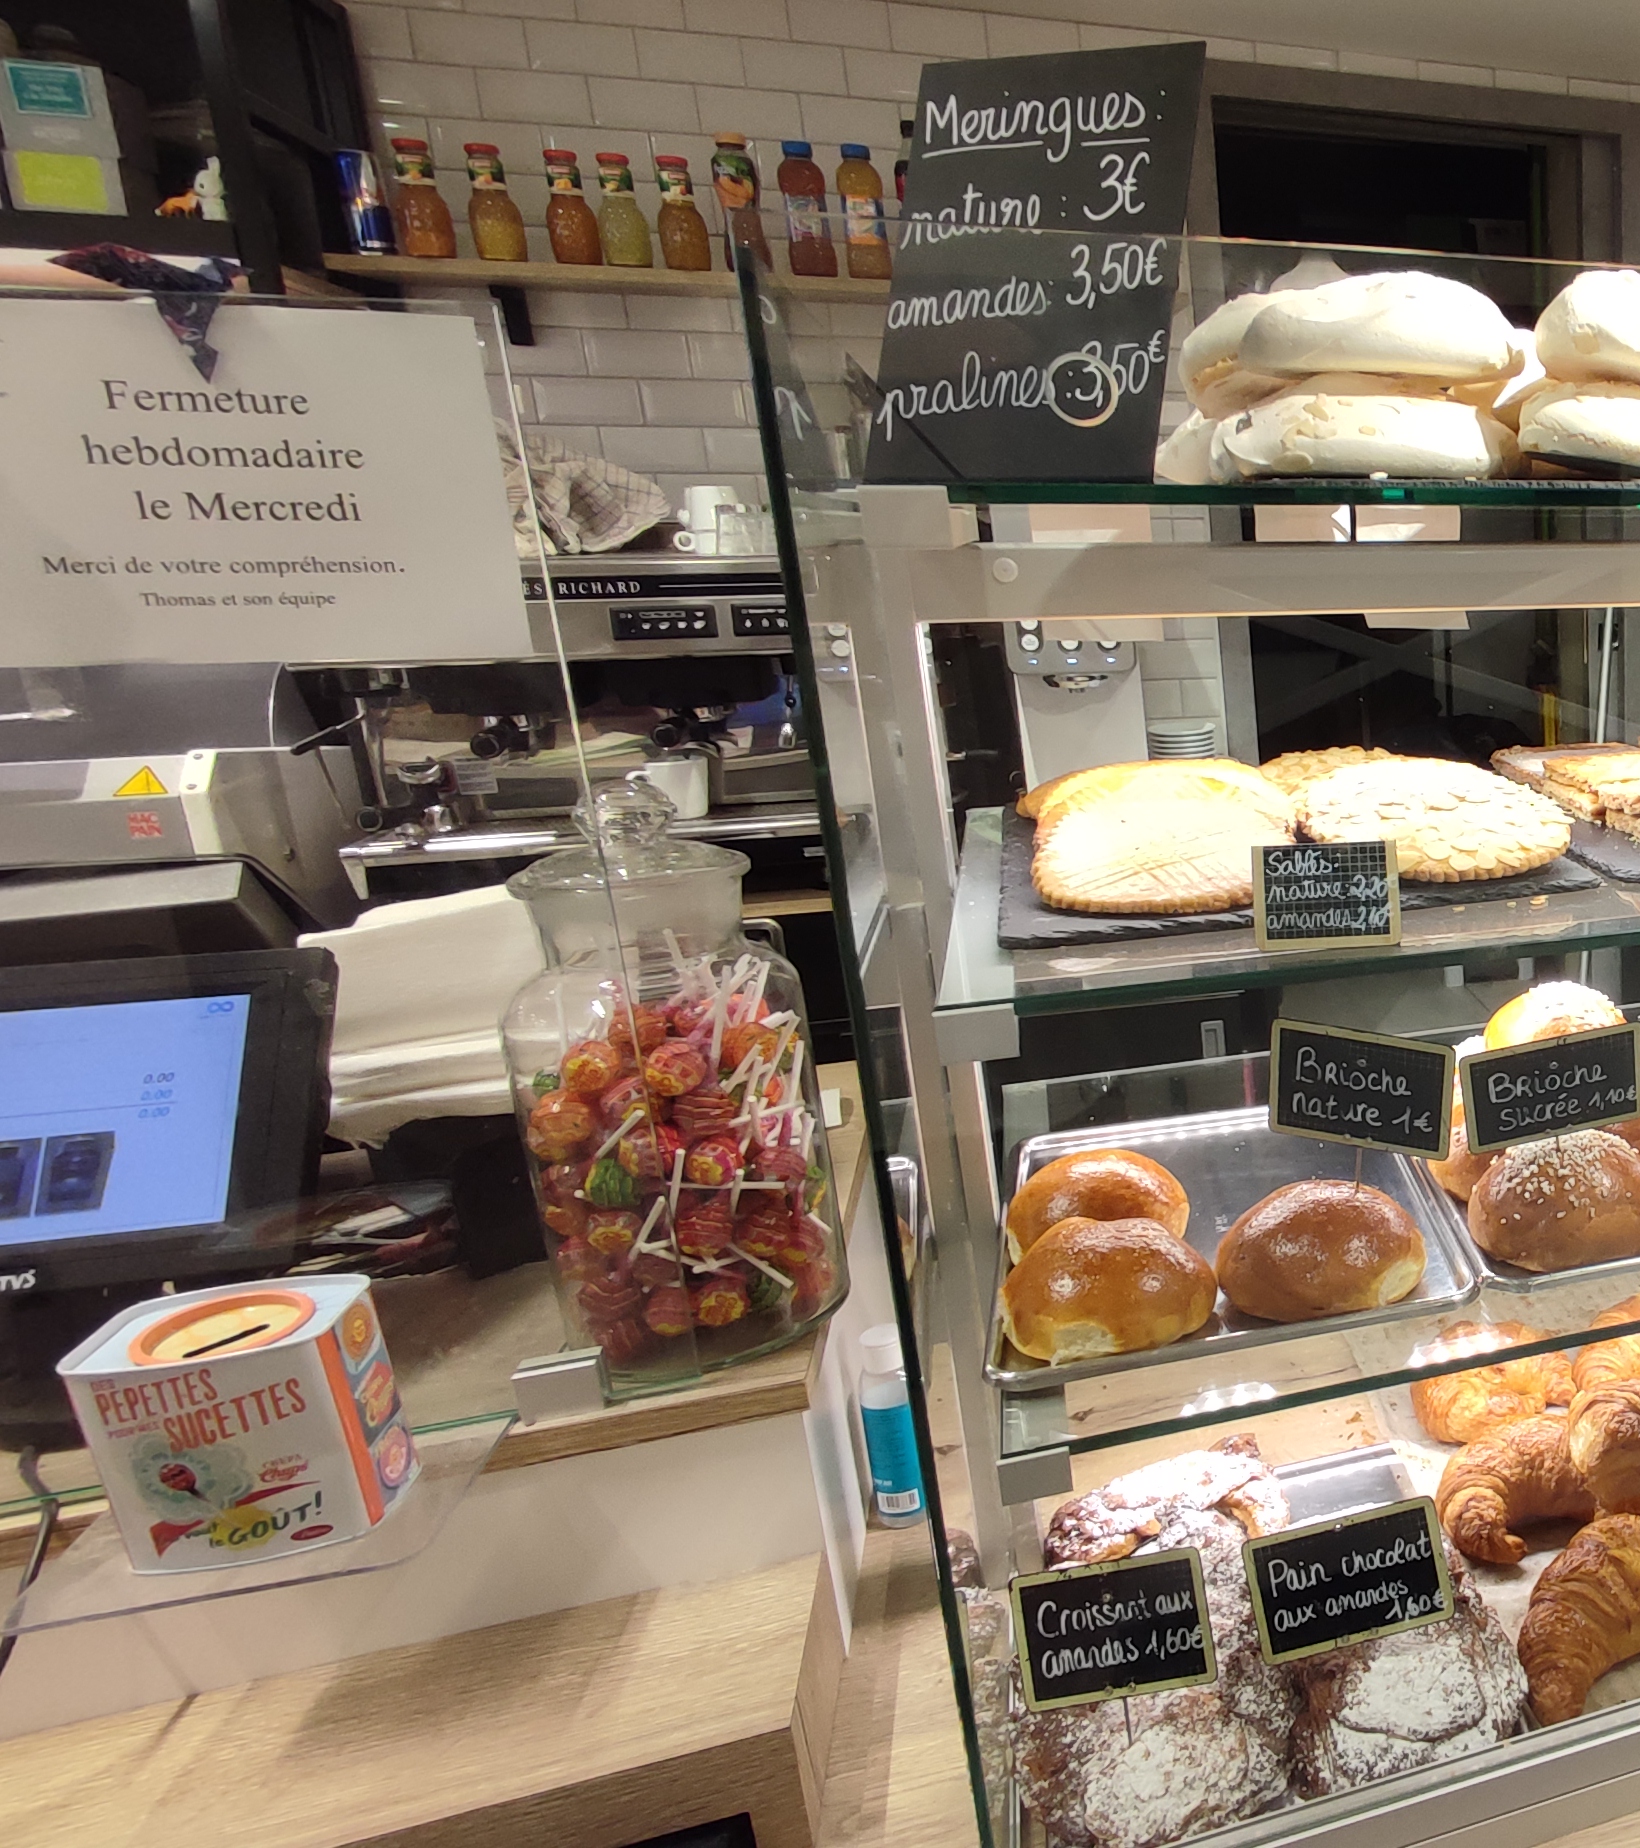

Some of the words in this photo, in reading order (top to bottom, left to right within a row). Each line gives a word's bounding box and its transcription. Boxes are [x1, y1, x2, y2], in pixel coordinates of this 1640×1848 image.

[1083, 152, 1150, 221] 3€
[1066, 238, 1167, 310] 3,50€
[101, 379, 310, 415] Fermeture
[81, 434, 366, 470] hebdomadaire
[134, 490, 172, 521] le
[183, 491, 363, 523] Mercredi
[42, 556, 117, 576] Merci
[125, 557, 154, 575] de
[161, 558, 222, 575] votre
[230, 556, 406, 579] compréhension.
[558, 581, 641, 595] RICHARD
[140, 592, 217, 608] Thomas
[222, 593, 238, 608] et
[243, 594, 273, 608] son
[278, 592, 337, 610] équipe
[127, 812, 158, 826] MAC
[1292, 1091, 1382, 1127] nature
[1391, 1106, 1434, 1135] 1€
[1498, 1092, 1582, 1133] sucrée
[1588, 1085, 1638, 1112] 1,10€
[93, 1368, 218, 1427] PEPETTES
[163, 1378, 307, 1453] SUCETTES
[1267, 1558, 1333, 1598] Pain
[1341, 1529, 1432, 1578] chocolat
[1036, 1589, 1152, 1640] Croissant
[1154, 1589, 1194, 1616] aux
[1274, 1603, 1318, 1633] aux
[1325, 1579, 1409, 1617] amandes
[1384, 1587, 1449, 1623] 1,60€
[1041, 1636, 1140, 1680] amandes
[1144, 1624, 1206, 1661] 1,60€
